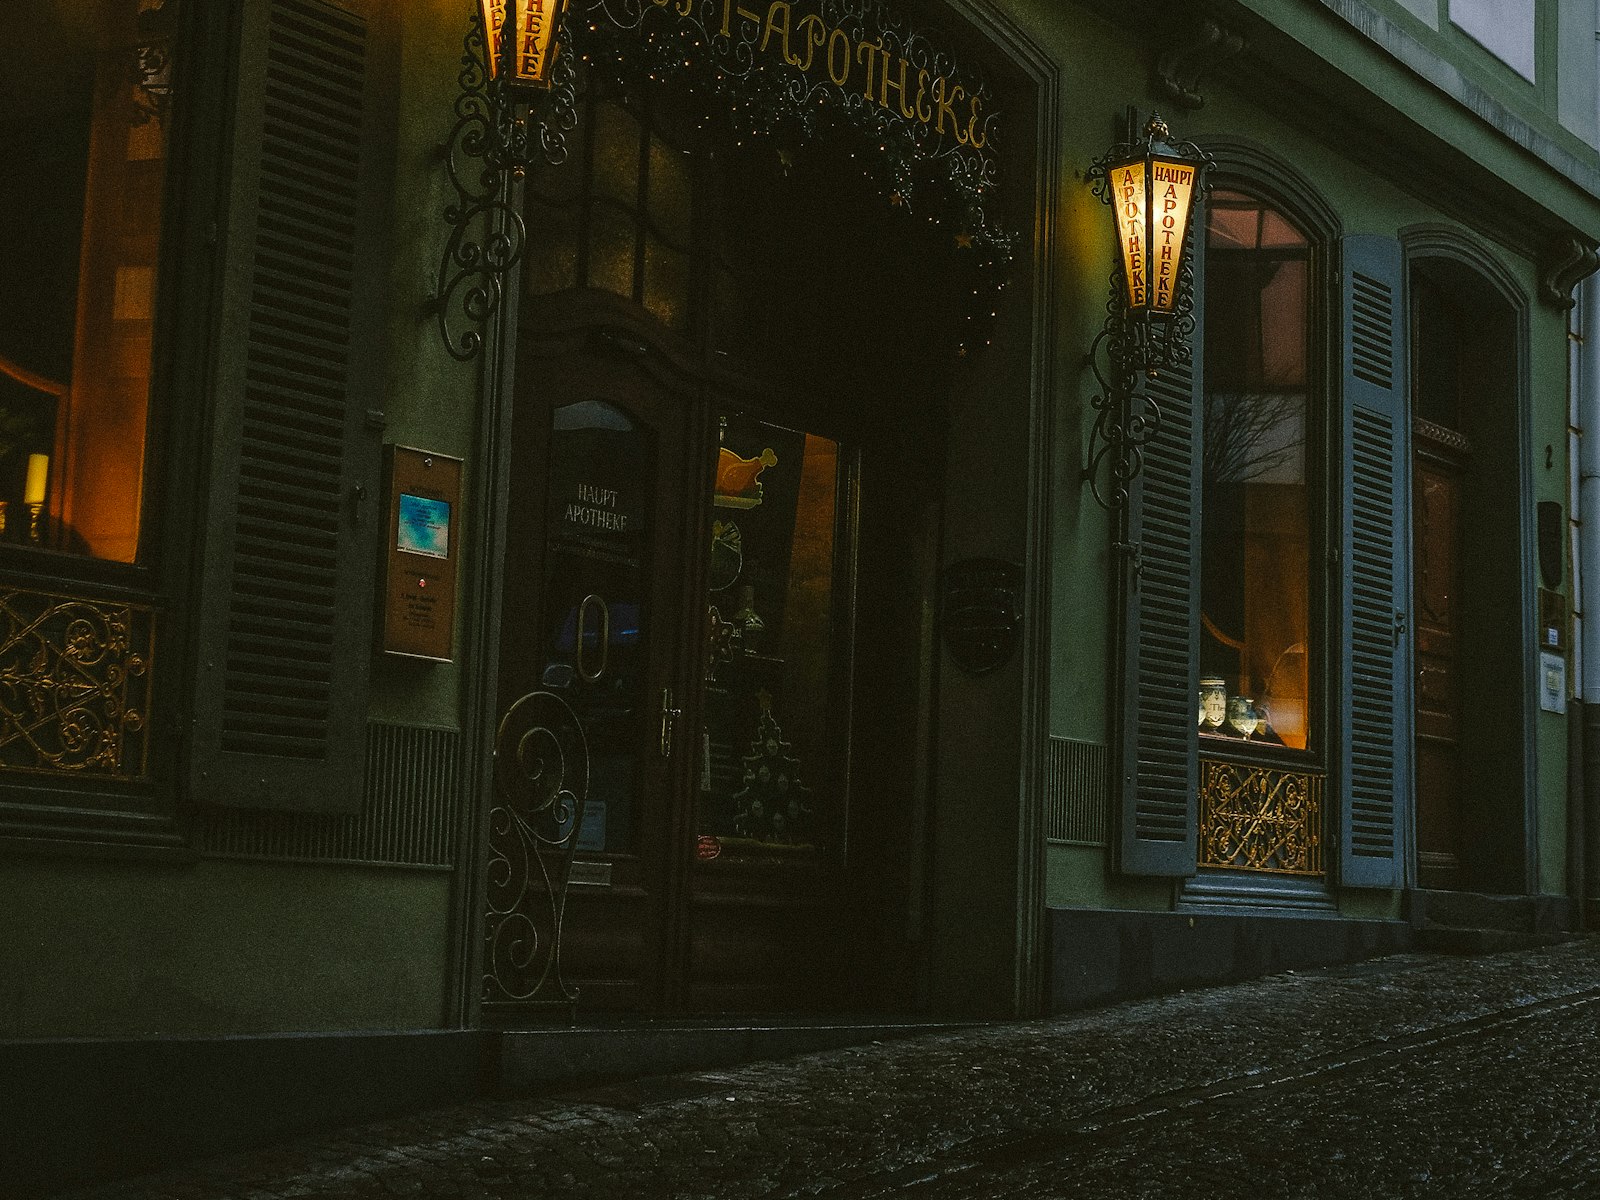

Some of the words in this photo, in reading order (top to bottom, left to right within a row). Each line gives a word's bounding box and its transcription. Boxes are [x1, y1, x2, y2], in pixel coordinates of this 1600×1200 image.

[1154, 166, 1193, 186] HAUPT
[1122, 169, 1145, 305] APOTHEKE
[1157, 184, 1178, 307] APOTHEKE
[1545, 444, 1553, 470] 2
[578, 483, 618, 507] HAUPT
[564, 504, 628, 532] APOTHEKE
